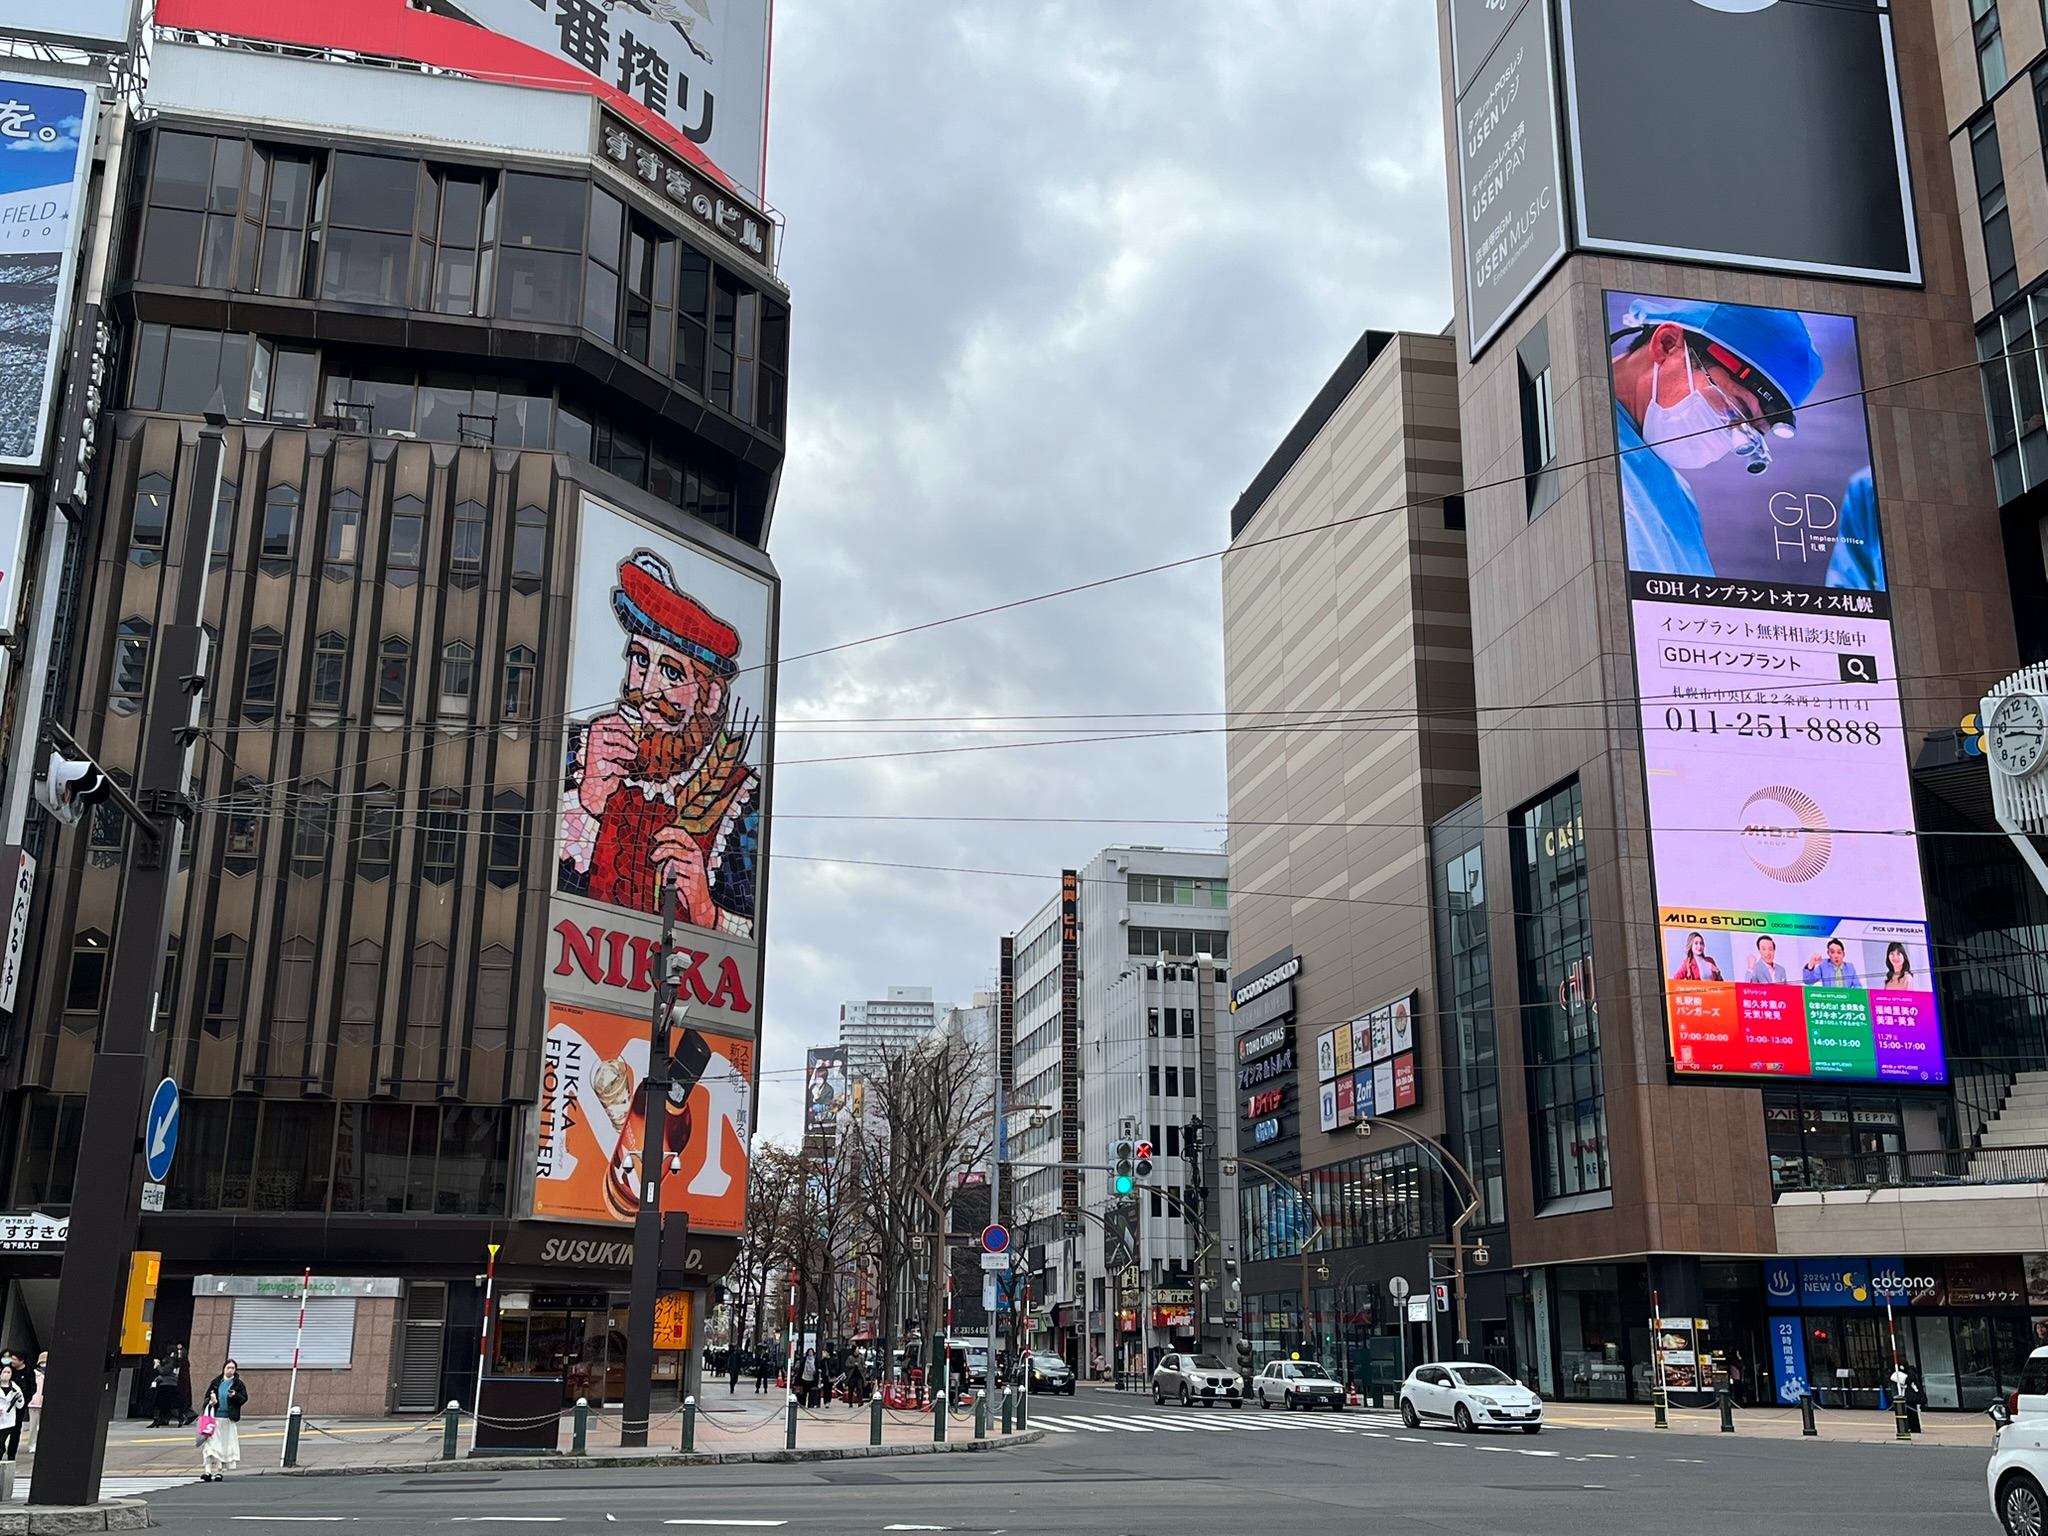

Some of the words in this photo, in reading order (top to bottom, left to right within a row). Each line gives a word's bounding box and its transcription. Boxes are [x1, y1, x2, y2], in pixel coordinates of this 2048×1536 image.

[530, 0, 714, 143] 番搾り
[1469, 104, 1500, 158] USEN
[1501, 74, 1519, 114] レジ
[1472, 120, 1525, 197] キャッシュレス決済
[1473, 170, 1504, 223] USEN
[1506, 138, 1526, 181] PAY
[604, 126, 762, 253] すすきのビル
[2, 201, 57, 224] FIELD
[1477, 237, 1508, 288] USEN
[1510, 186, 1550, 249] MUSIC
[1840, 536, 1865, 545] Office
[1646, 579, 1684, 597] GDH
[1689, 582, 1874, 614] インプラントオフィス札幌
[1661, 616, 1867, 647] インプラント無料相談実施中
[1664, 646, 1801, 672] GDHインプラント
[2010, 699, 2021, 712] 12
[2024, 700, 2029, 711] 1
[2002, 708, 2010, 720] 11
[2032, 706, 2039, 718] 2
[1665, 707, 1882, 746] 011-251-8888
[1998, 721, 2006, 734] 10
[2037, 719, 2043, 730] 3
[1997, 737, 2003, 748] 9
[2035, 735, 2041, 746] 4
[2002, 749, 2008, 761] 8
[2029, 747, 2036, 759] 5
[2010, 755, 2017, 767] 7
[2020, 756, 2027, 767] 6
[1711, 916, 1768, 928] STUDIO
[1872, 925, 1885, 933] PICK
[1897, 927, 1924, 935] PROGRAM
[553, 918, 752, 1013] NIKKA
[1245, 1038, 1260, 1053] TOHO
[1260, 1026, 1285, 1050] CINEMAS
[1745, 1035, 1793, 1045] 12:00-13:00
[1813, 1038, 1861, 1048] 14:00-15:00
[1879, 1040, 1926, 1051] 15:00-17:00
[560, 1041, 581, 1132] NIKKA
[1356, 1080, 1373, 1102] Zoff
[536, 1037, 561, 1178] FRONTIER
[1832, 1111, 1894, 1123] THEEPPY
[3, 1242, 40, 1250] 地下鉄入口
[541, 1239, 634, 1266] SUSUKIN
[298, 1283, 336, 1291] TBACCO
[1804, 1282, 1831, 1292] NEW
